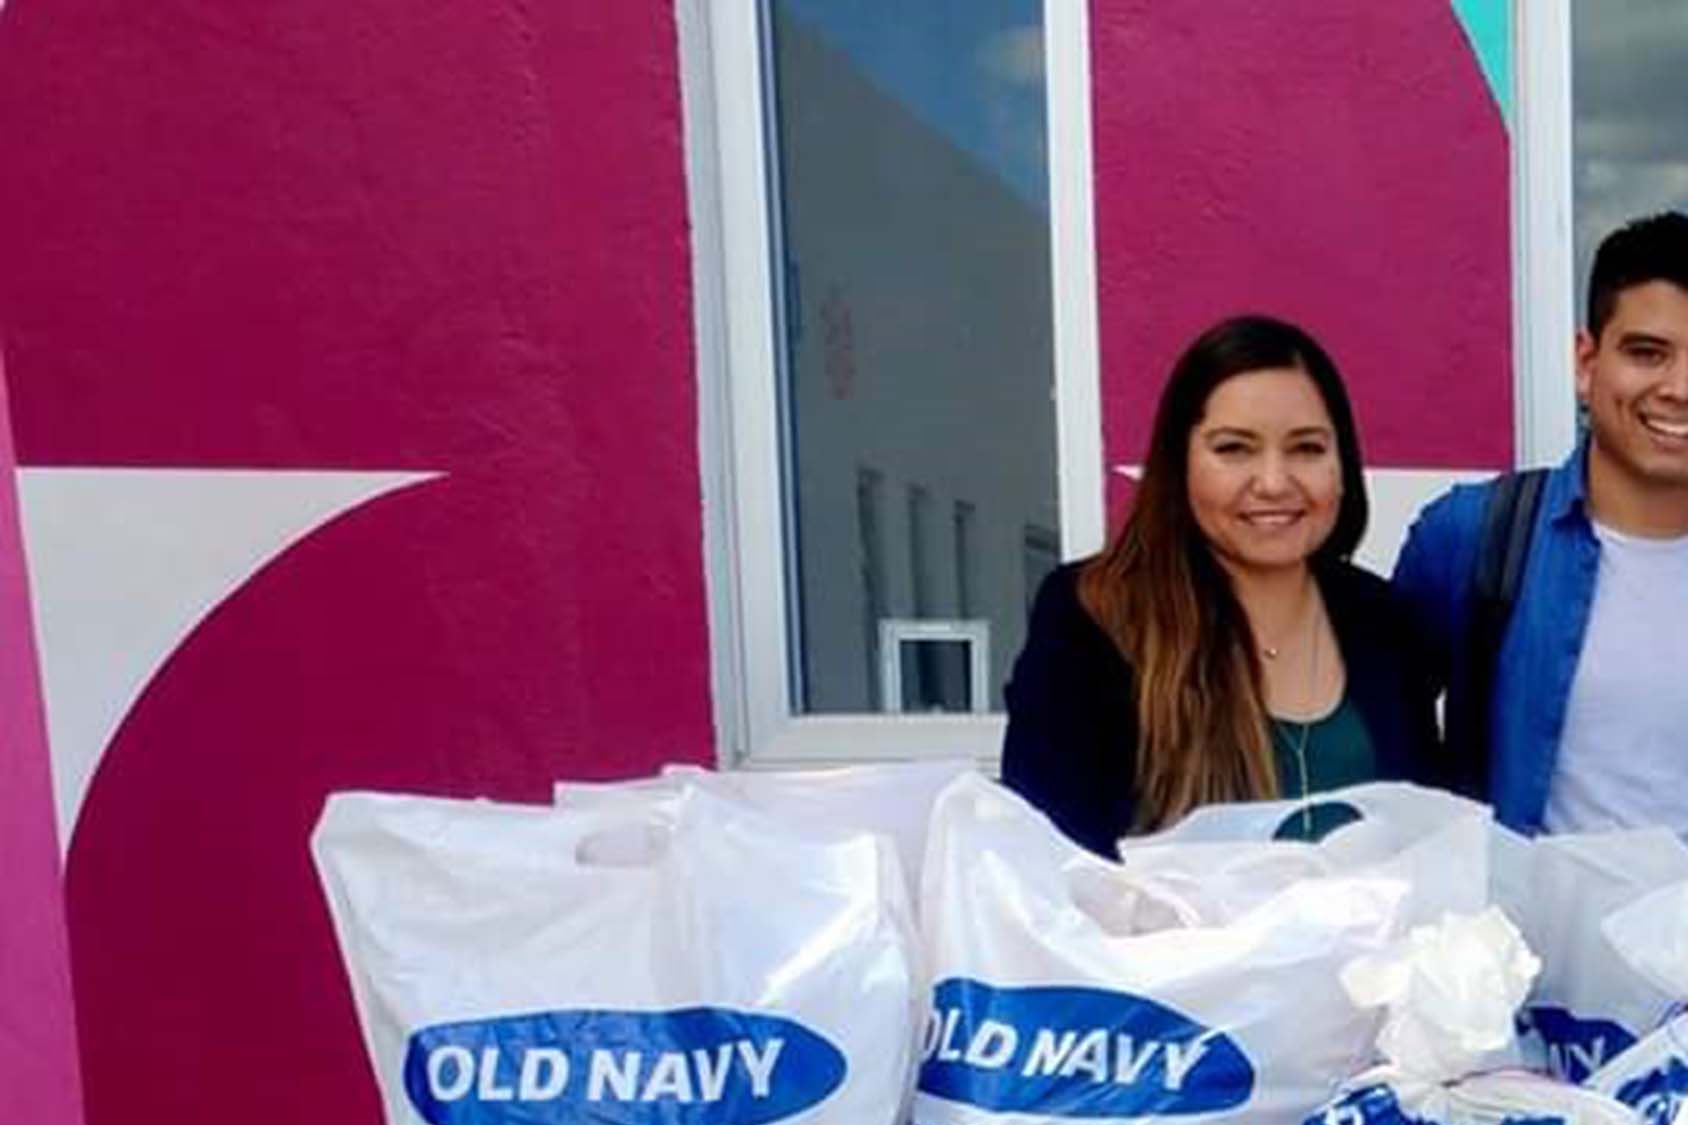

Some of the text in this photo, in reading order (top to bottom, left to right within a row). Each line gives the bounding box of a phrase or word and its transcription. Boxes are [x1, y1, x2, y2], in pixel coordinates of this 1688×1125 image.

[426, 1038, 783, 1103] OLD NAVY
[1020, 1028, 1207, 1091] NAVY
